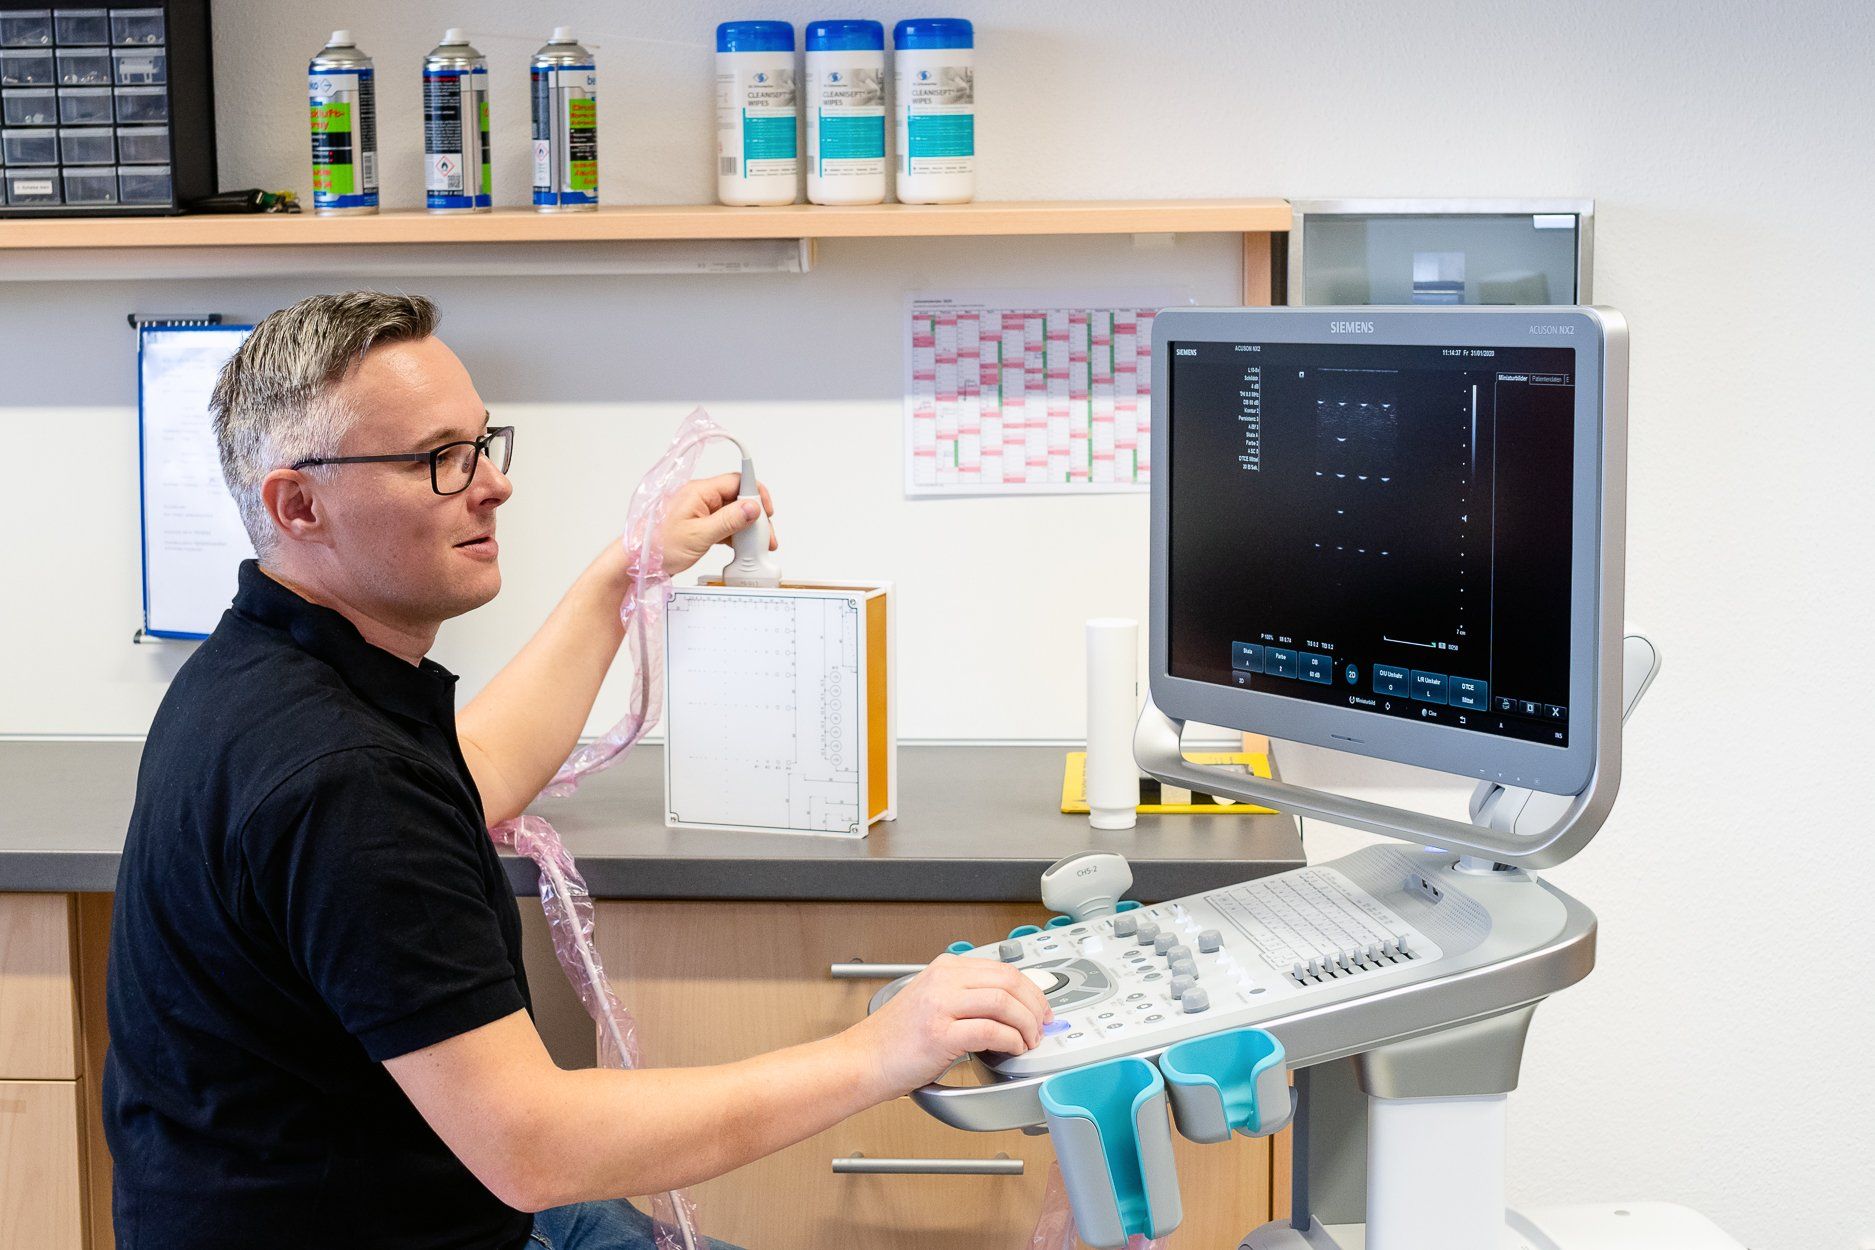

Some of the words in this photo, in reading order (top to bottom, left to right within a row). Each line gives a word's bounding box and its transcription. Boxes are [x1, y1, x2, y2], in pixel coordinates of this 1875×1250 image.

[1330, 322, 1374, 333] SIEMENS
[1529, 325, 1557, 334] ACUSON
[1560, 326, 1574, 334] NX2
[1076, 865, 1096, 877] CH5-2
